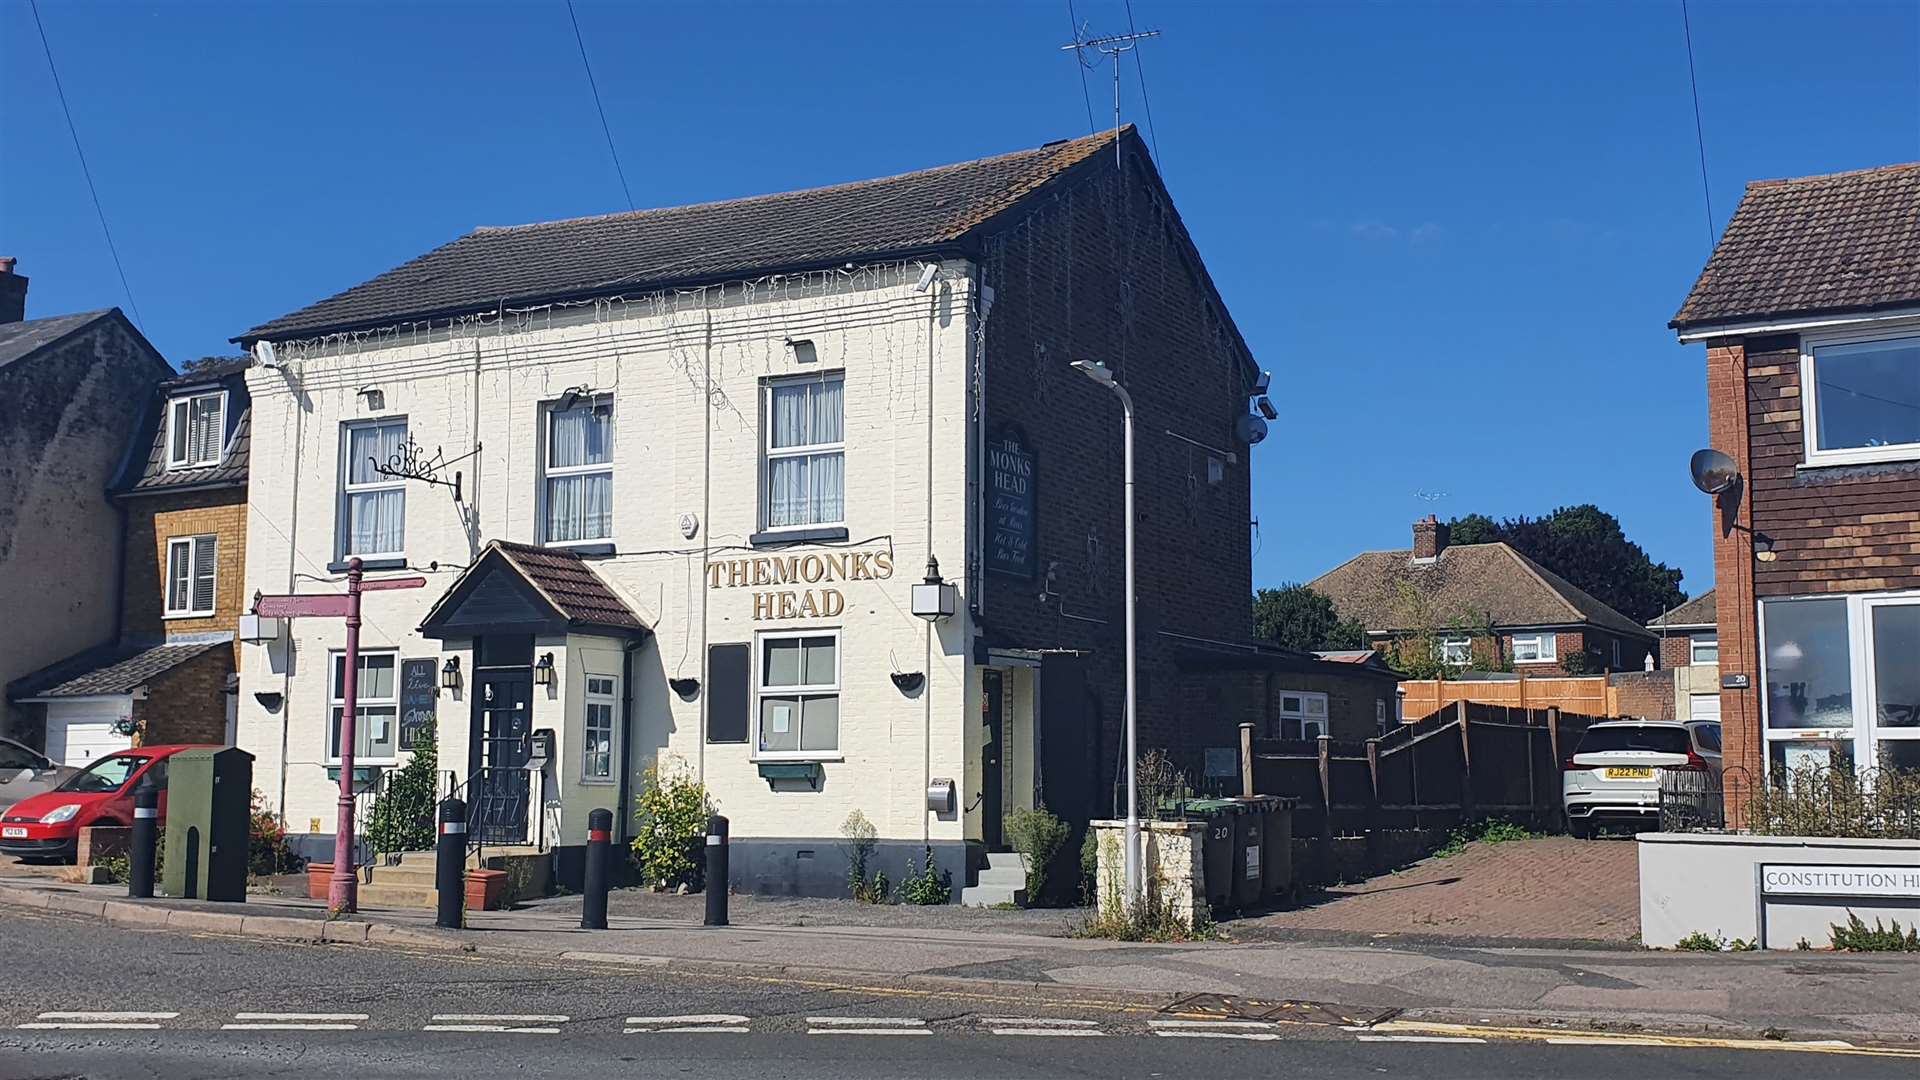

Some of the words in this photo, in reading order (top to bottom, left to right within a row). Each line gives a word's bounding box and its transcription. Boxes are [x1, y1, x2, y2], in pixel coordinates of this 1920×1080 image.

[1003, 439, 1021, 455] THE
[990, 450, 1031, 477] MONKS
[994, 471, 1027, 495] HEAD
[752, 588, 845, 621] HEAD
[1735, 674, 1746, 683] 20
[1607, 768, 1630, 777] RJ22
[1632, 768, 1650, 777] PNU
[1214, 827, 1228, 840] 20
[1766, 872, 1897, 888] CONSTITUTION
